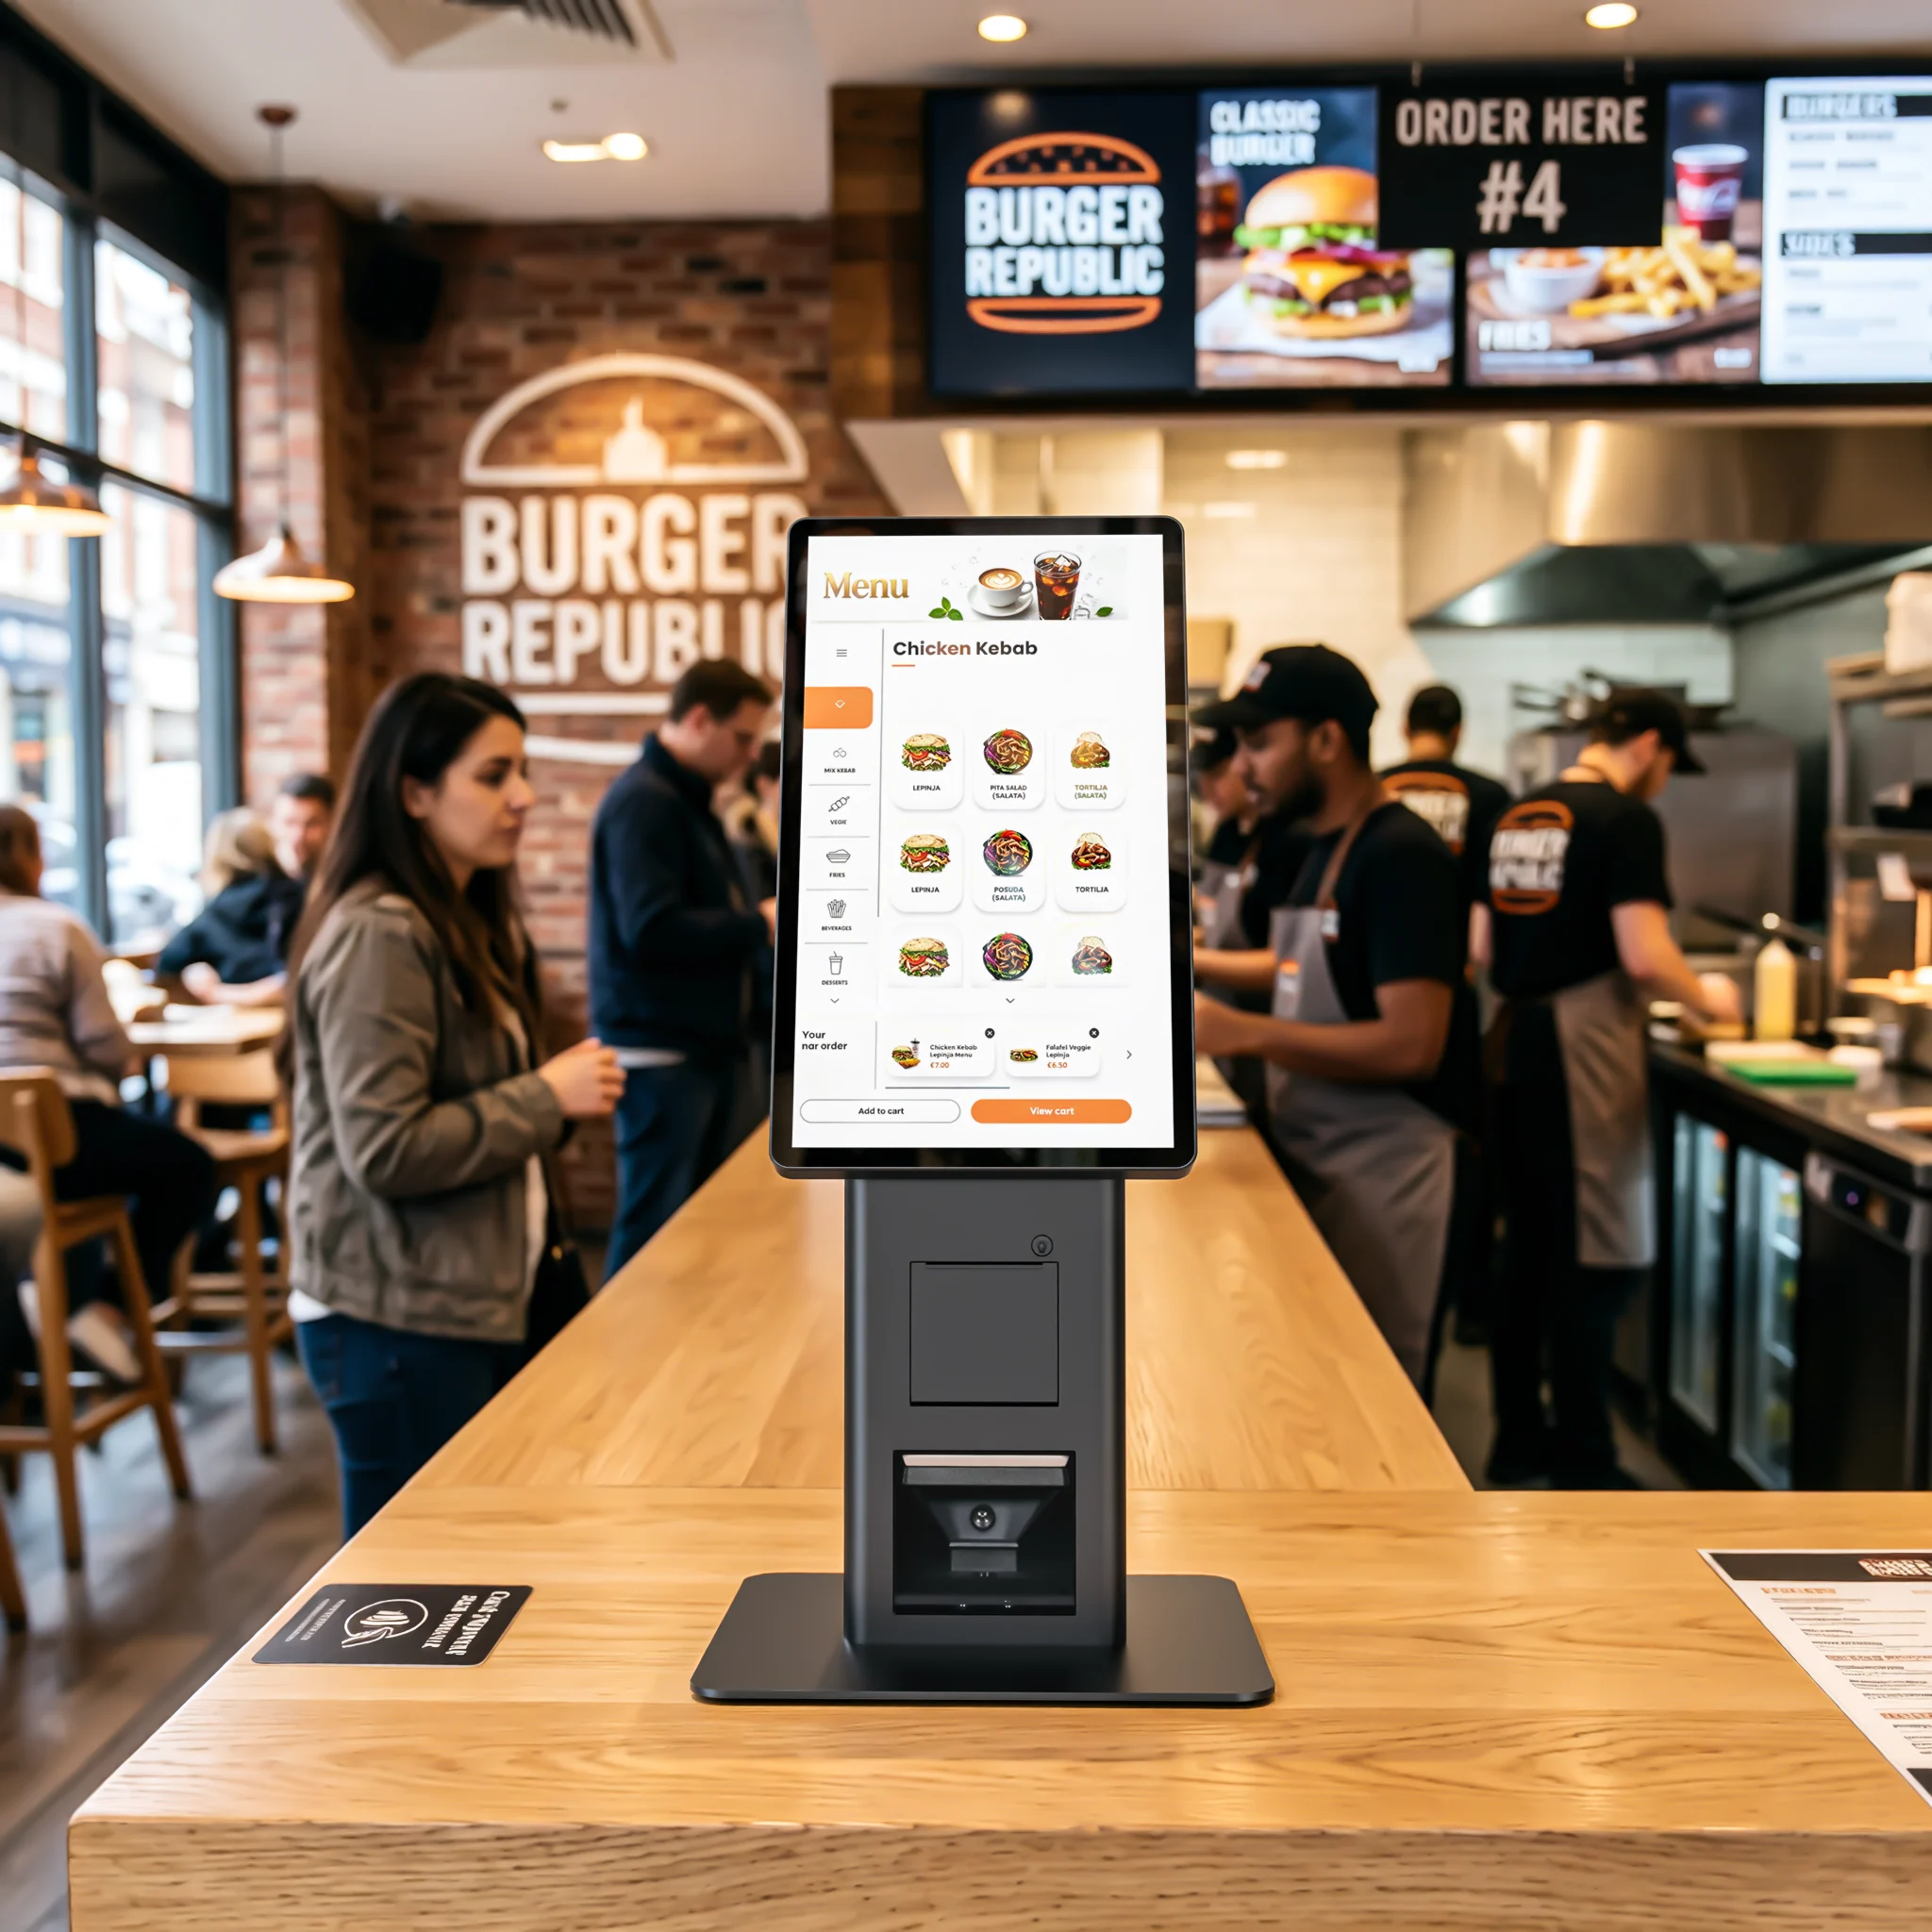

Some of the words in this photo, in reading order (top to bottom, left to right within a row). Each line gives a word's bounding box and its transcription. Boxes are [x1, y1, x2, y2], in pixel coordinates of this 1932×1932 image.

[1395, 98, 1530, 145] ORDER
[1542, 96, 1649, 143] HERE
[1475, 159, 1567, 234] #4
[965, 185, 1164, 246] BURGER
[965, 245, 1164, 297] REPUBLIC
[460, 492, 808, 596] BURGER
[824, 572, 909, 599] Menu
[892, 640, 971, 657] Chicken
[975, 640, 1038, 656] Kebab
[991, 792, 1026, 801] (SALATA)
[1074, 792, 1108, 801] (SALATA)
[991, 894, 1026, 903] (SALATA)
[801, 1030, 826, 1040] Your
[801, 1042, 819, 1051] nar
[820, 1041, 848, 1051] order
[1068, 1043, 1091, 1052] Veggie
[1045, 1051, 1070, 1059] Lepinja
[1046, 1060, 1069, 1069] €6.50
[858, 1107, 876, 1115] Add
[1029, 1107, 1053, 1116] View
[1054, 1108, 1075, 1116] cart
